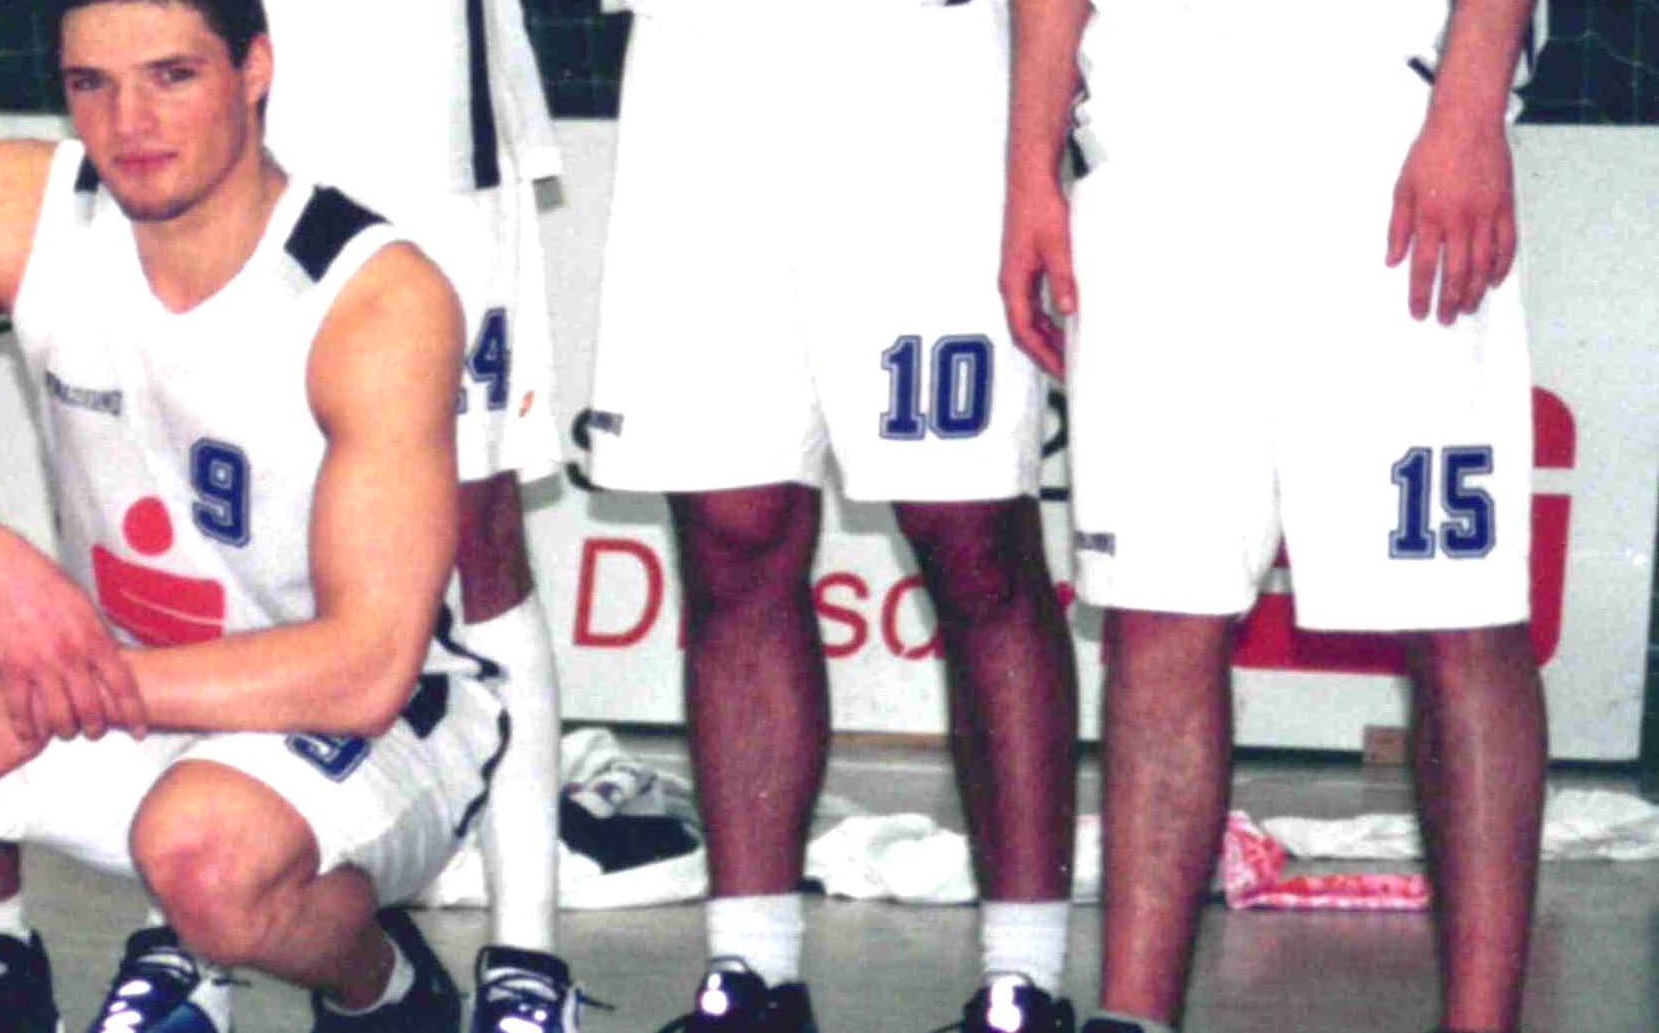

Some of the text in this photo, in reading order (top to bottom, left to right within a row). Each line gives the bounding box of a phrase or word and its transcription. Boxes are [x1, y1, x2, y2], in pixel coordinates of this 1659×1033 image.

[455, 307, 511, 414] 4
[879, 333, 993, 440] 10
[189, 437, 251, 548] 9
[1387, 444, 1496, 560] 15
